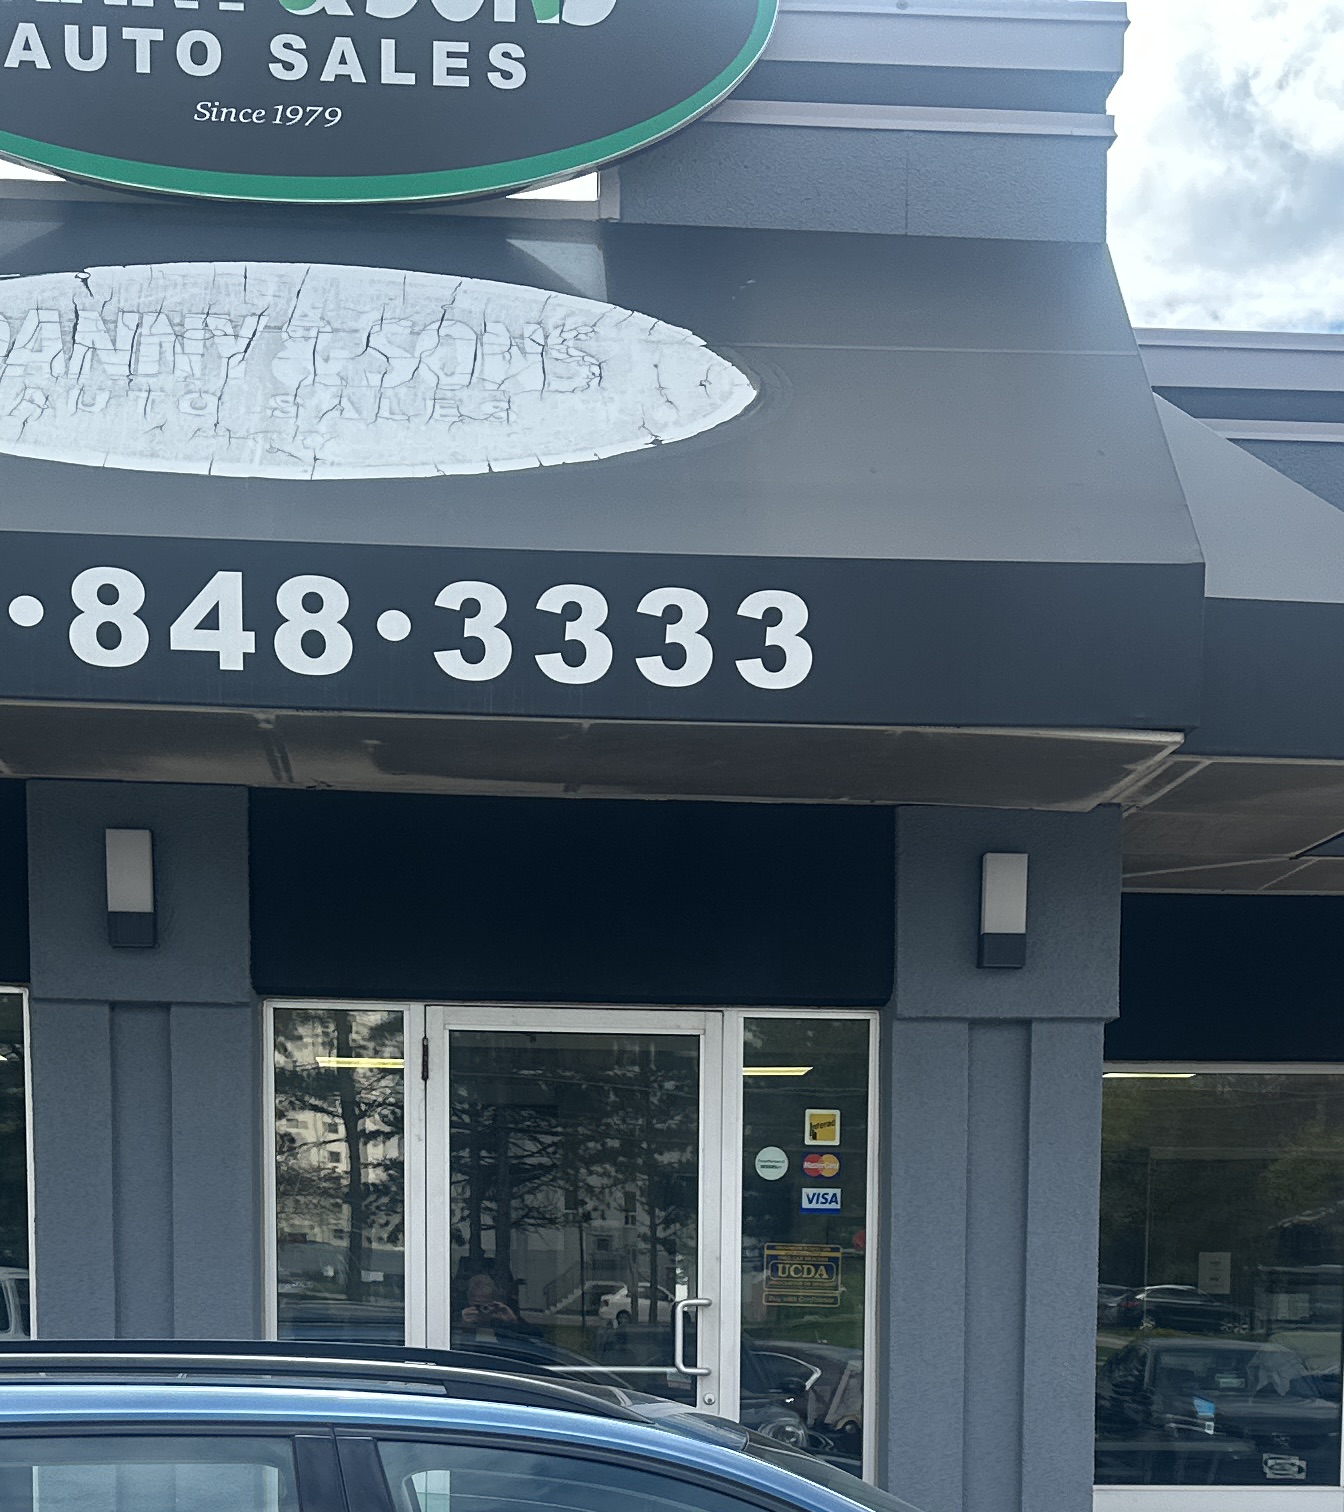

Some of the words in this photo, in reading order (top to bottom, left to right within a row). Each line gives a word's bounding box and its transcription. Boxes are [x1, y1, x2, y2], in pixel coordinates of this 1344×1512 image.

[3, 22, 223, 77] AUTO
[268, 33, 528, 90] SALES
[193, 100, 266, 126] Since
[271, 104, 343, 129] 1979
[806, 1193, 839, 1205] VISA
[777, 1263, 829, 1279] UCDA
